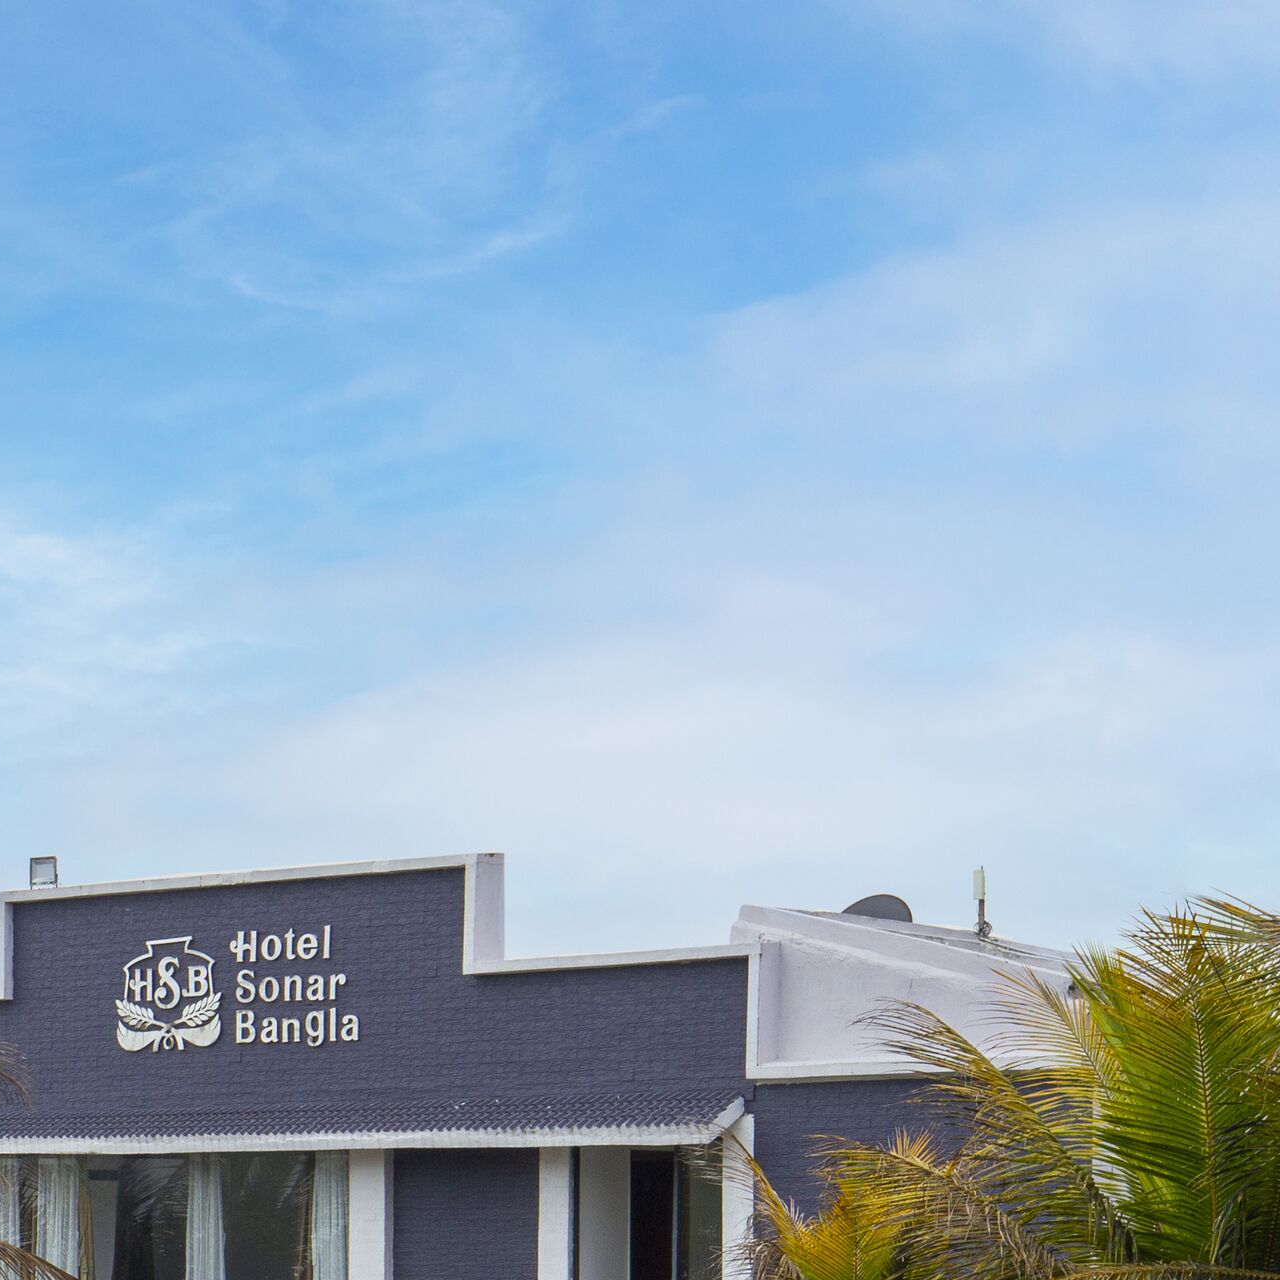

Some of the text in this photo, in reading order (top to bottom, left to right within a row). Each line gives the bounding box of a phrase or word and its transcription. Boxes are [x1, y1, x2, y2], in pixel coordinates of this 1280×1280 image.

[229, 924, 332, 963] Hotel
[129, 956, 209, 1010] HSB
[235, 969, 347, 1004] Sonar
[235, 1007, 360, 1047] Bangla
